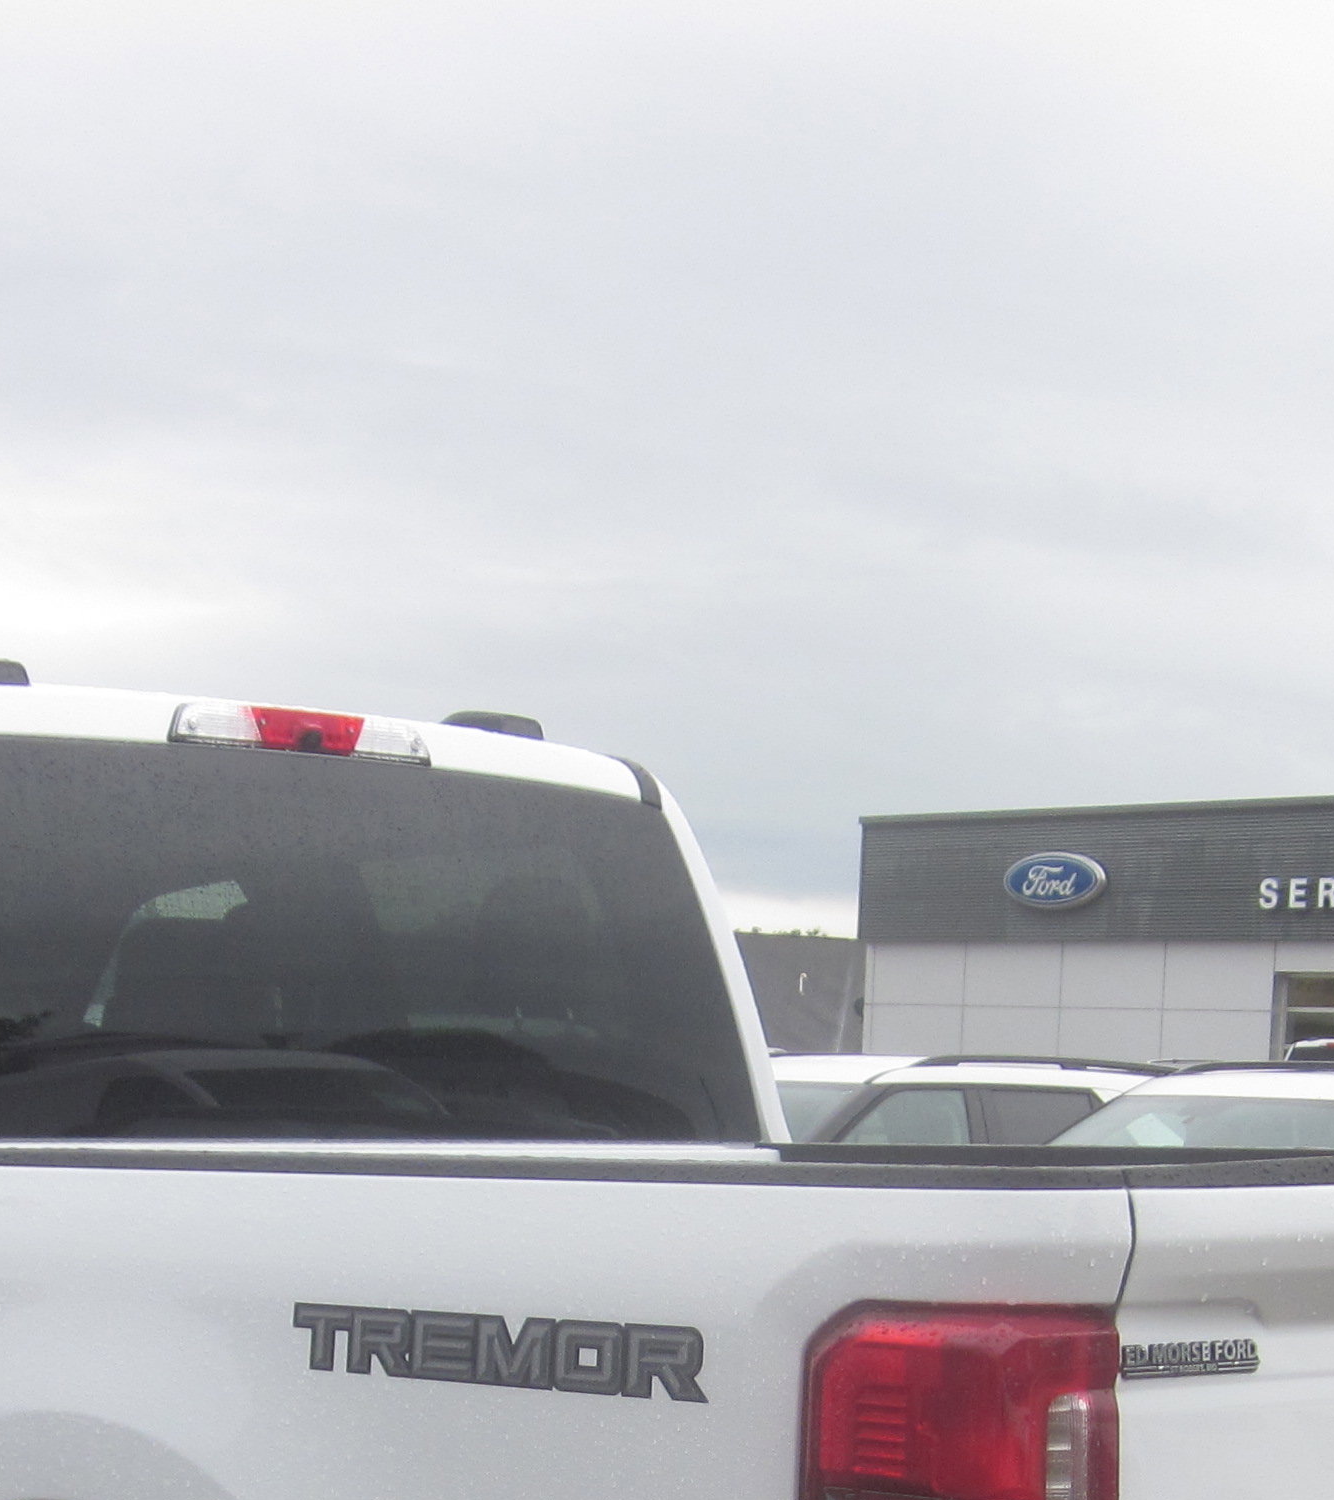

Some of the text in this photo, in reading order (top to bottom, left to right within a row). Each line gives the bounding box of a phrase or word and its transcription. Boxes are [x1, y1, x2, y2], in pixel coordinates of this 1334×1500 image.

[1022, 865, 1078, 896] Ford
[293, 1301, 709, 1404] TREMOR
[1123, 1339, 1258, 1366] ED MORSE FORD
